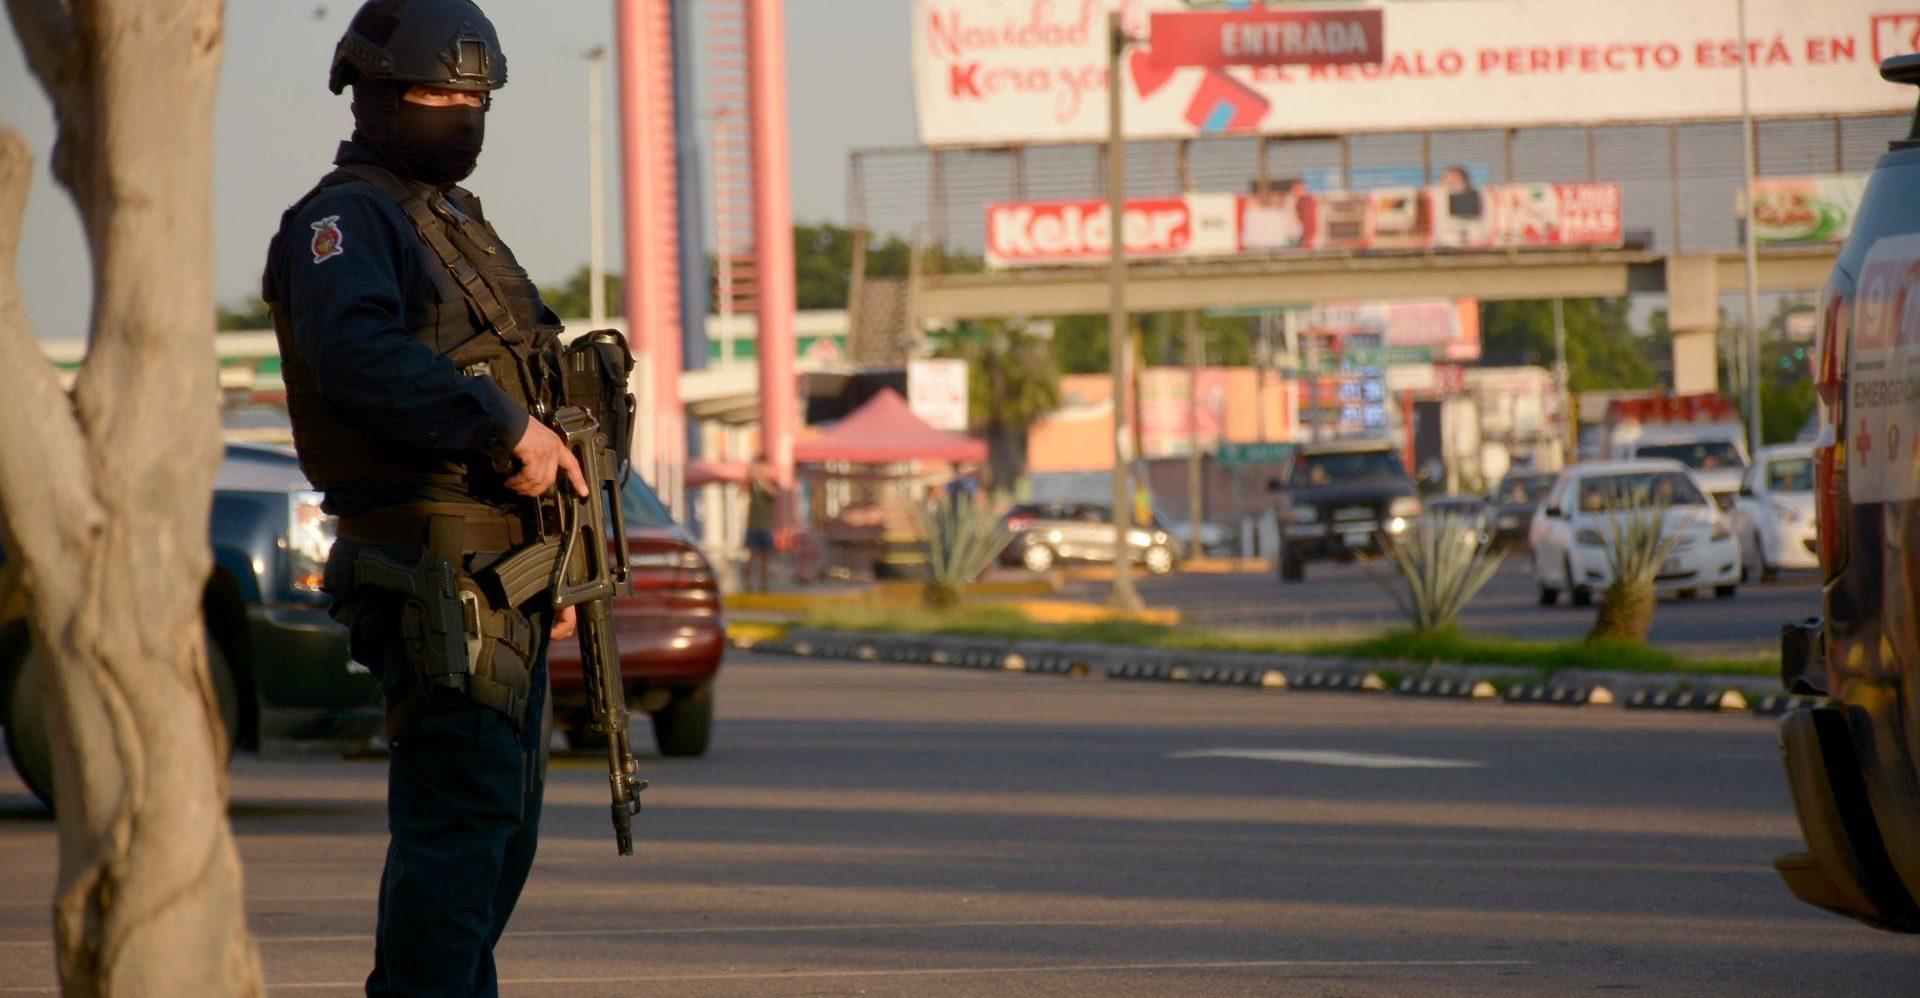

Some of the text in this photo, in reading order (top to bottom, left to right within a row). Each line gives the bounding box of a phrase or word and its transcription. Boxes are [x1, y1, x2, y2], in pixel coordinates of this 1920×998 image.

[1221, 21, 1367, 56] ENTRADA
[1479, 43, 1681, 75] PERFECTO
[1695, 31, 1792, 69] ESTÁ
[1806, 36, 1856, 64] EN
